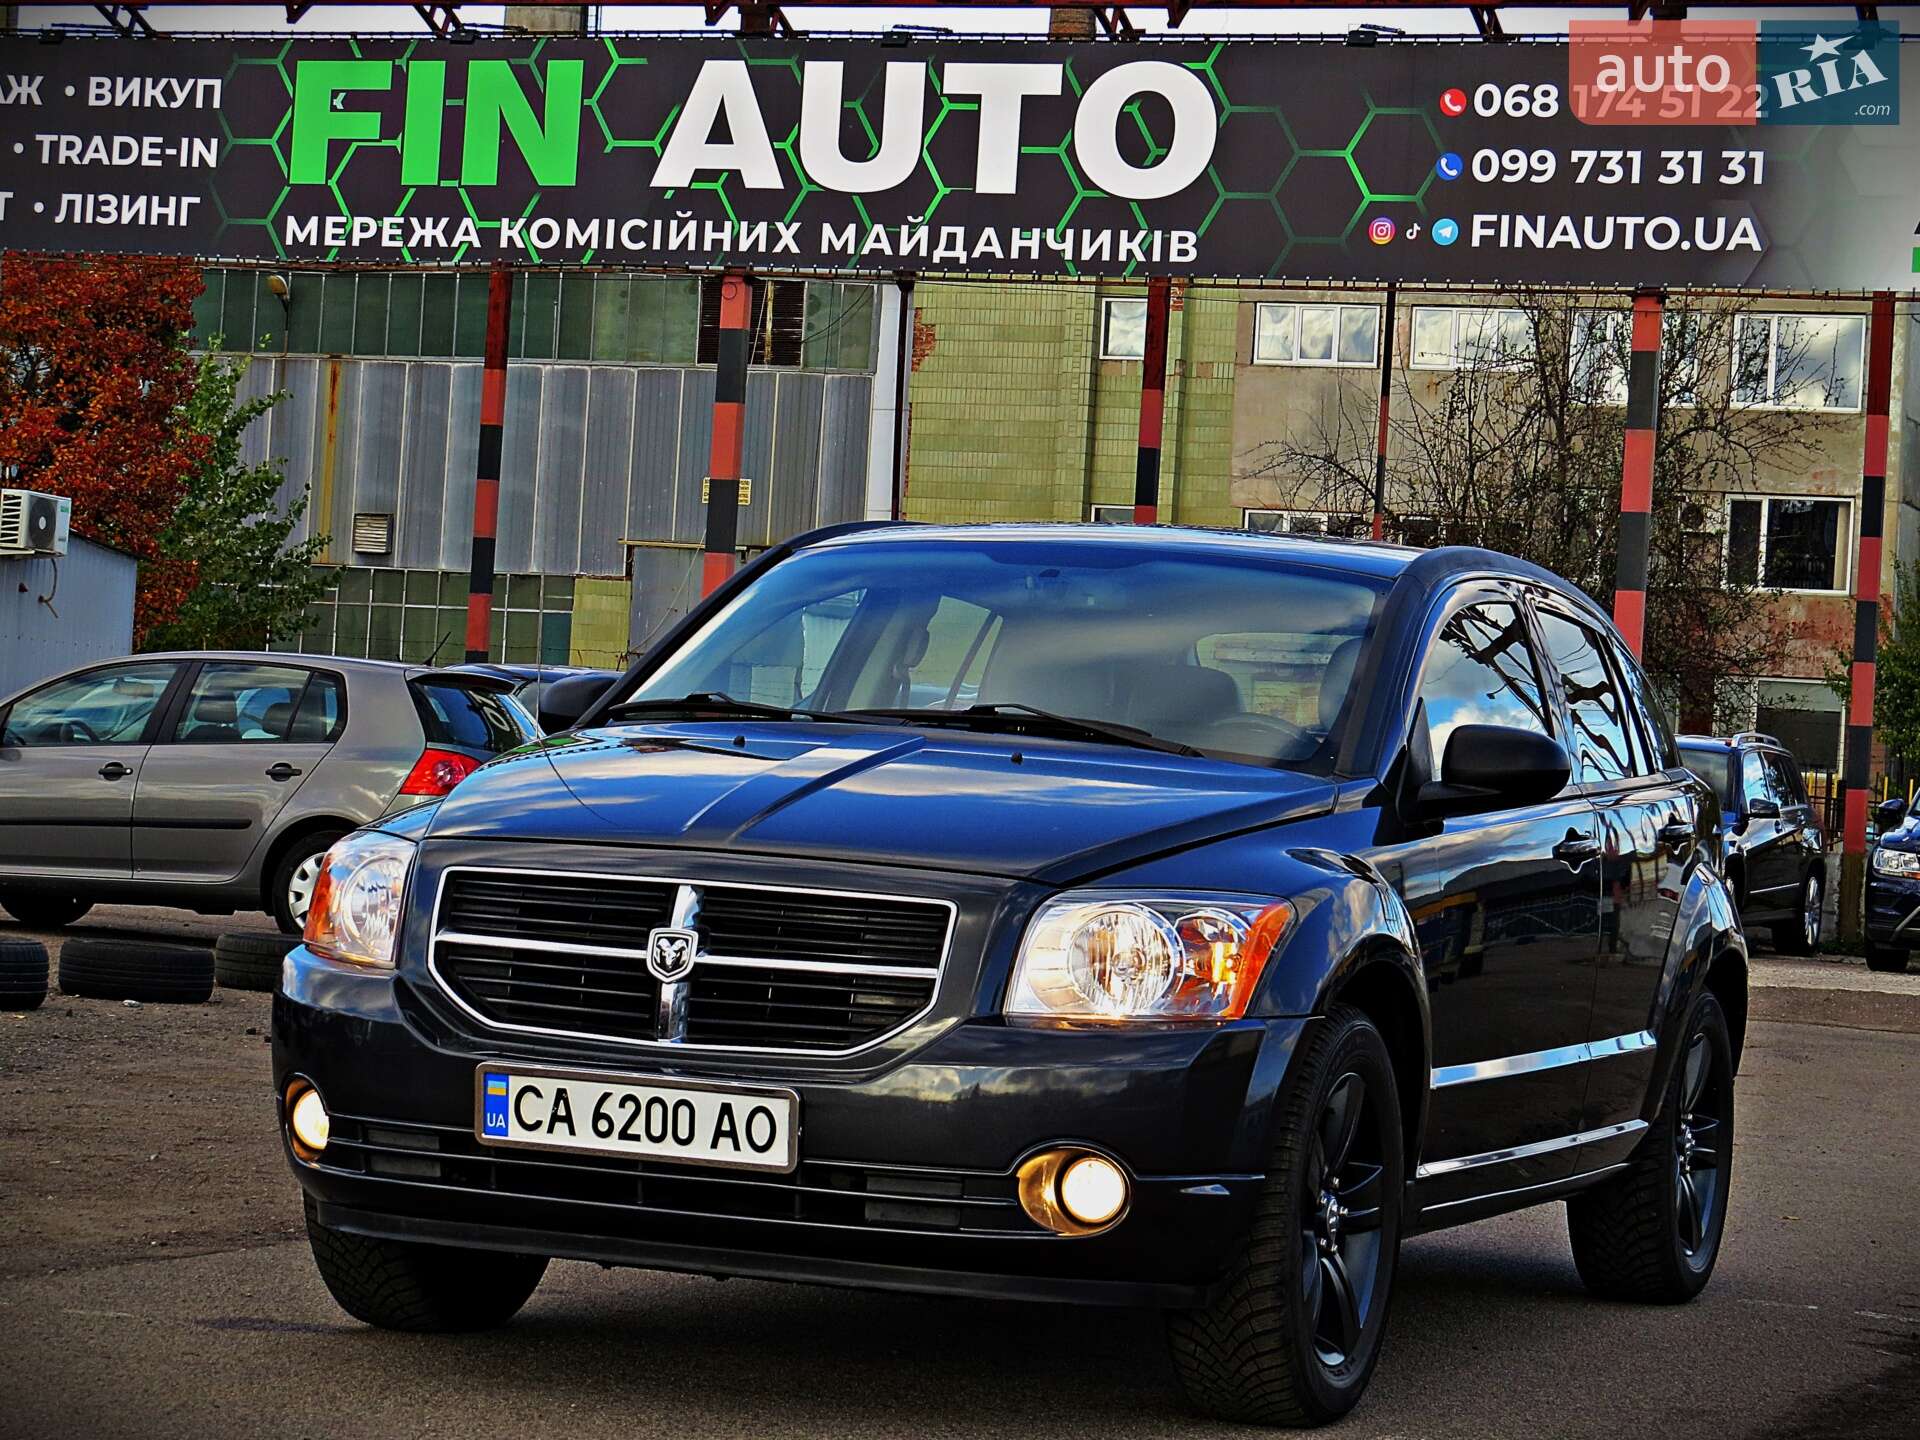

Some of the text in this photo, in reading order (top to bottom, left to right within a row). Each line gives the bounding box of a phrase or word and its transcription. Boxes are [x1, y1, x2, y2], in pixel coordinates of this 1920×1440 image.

[0, 75, 222, 109] Ж ВИКУП
[1473, 83, 1768, 119] 068 174 51 22
[289, 60, 1218, 200] FIN AUTO
[35, 134, 219, 168] TRADE-IN
[1471, 148, 1764, 186] 099 731 31 31
[54, 193, 201, 227] ЛІЗИНГ
[285, 210, 1199, 264] МЕРЕЖА КОМІСІЙНИХ МАЙДАНЧИКІВ
[1471, 214, 1763, 252] FINAUTO.UA
[486, 1112, 506, 1129] UA
[513, 1084, 777, 1154] CA 6200 AO
